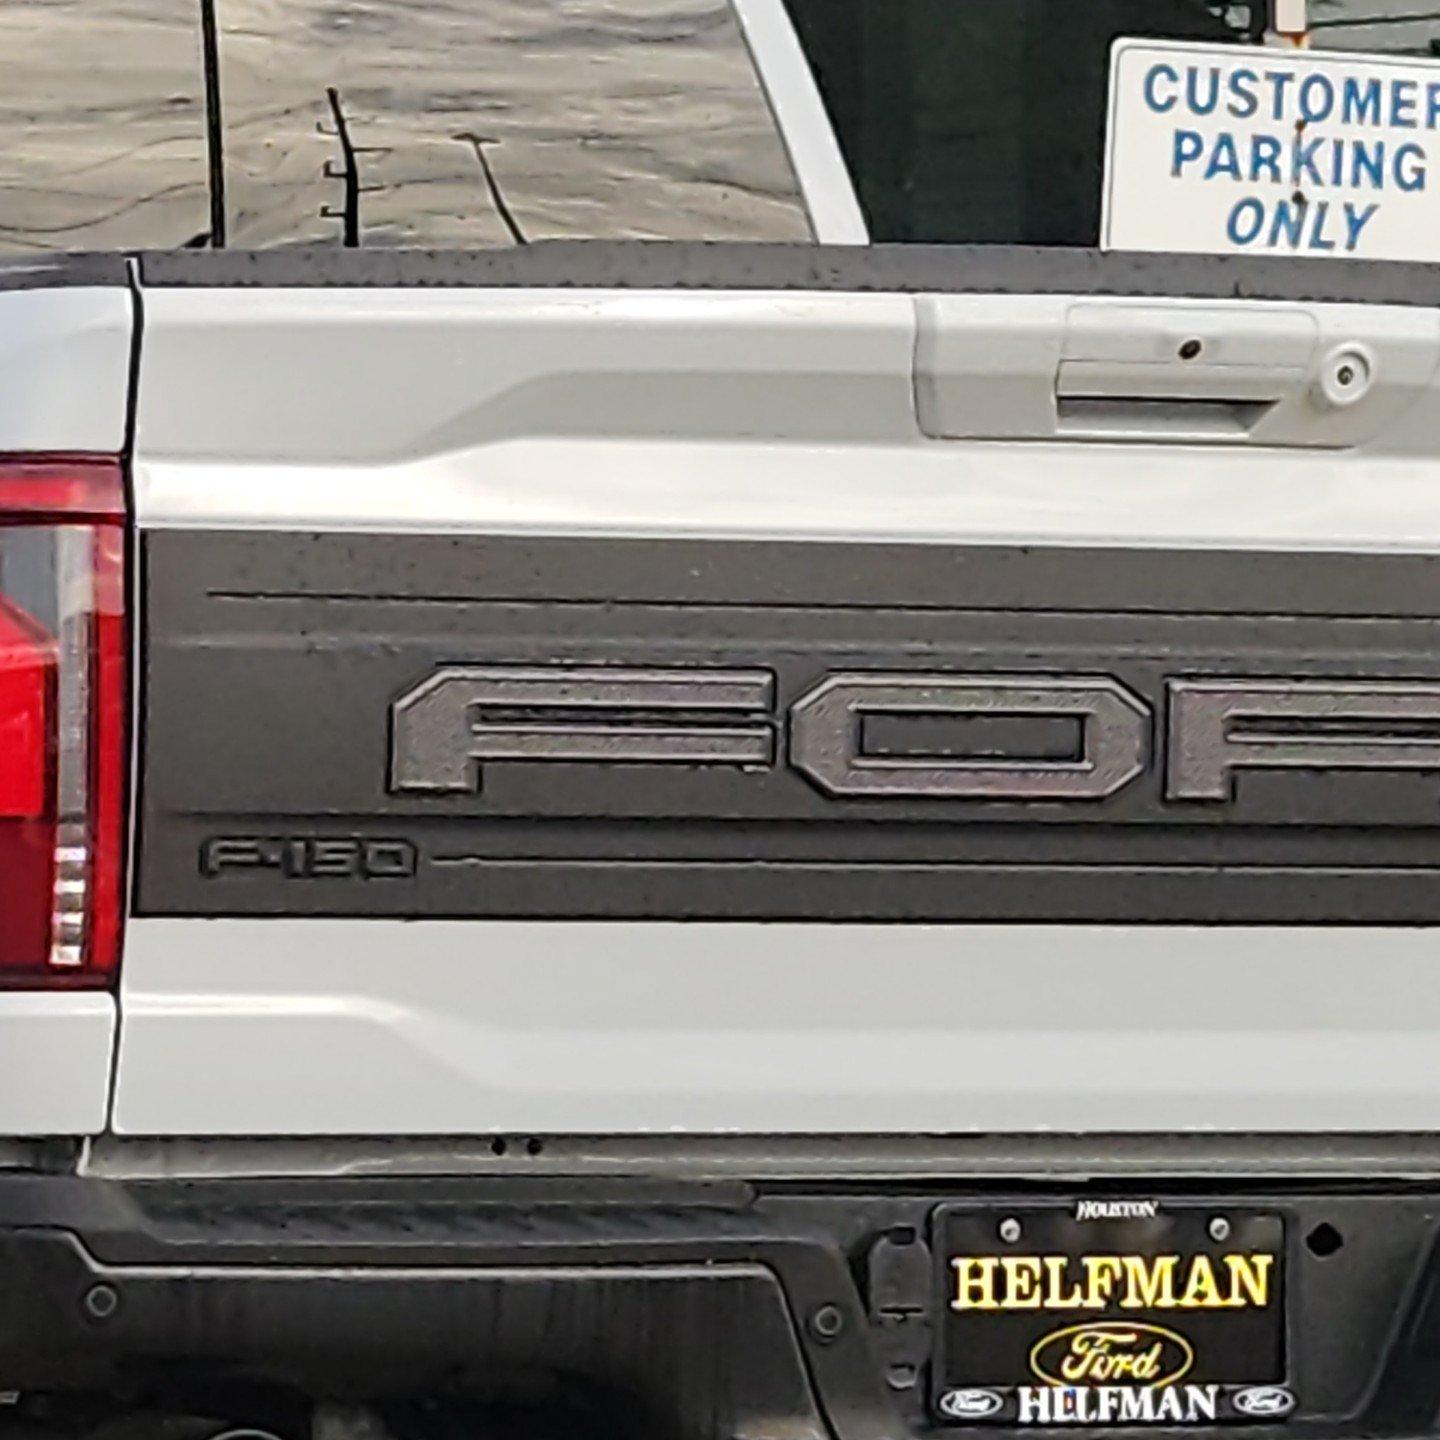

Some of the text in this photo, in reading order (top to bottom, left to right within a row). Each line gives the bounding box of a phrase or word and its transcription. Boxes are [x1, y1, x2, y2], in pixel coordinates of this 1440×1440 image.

[1170, 129, 1428, 192] PARKING
[1226, 196, 1380, 250] ONLY
[198, 835, 419, 879] F-150
[950, 1254, 1274, 1310] HELFMAN
[1062, 1331, 1161, 1381] Ford
[1018, 1386, 1220, 1422] HELFMAN
